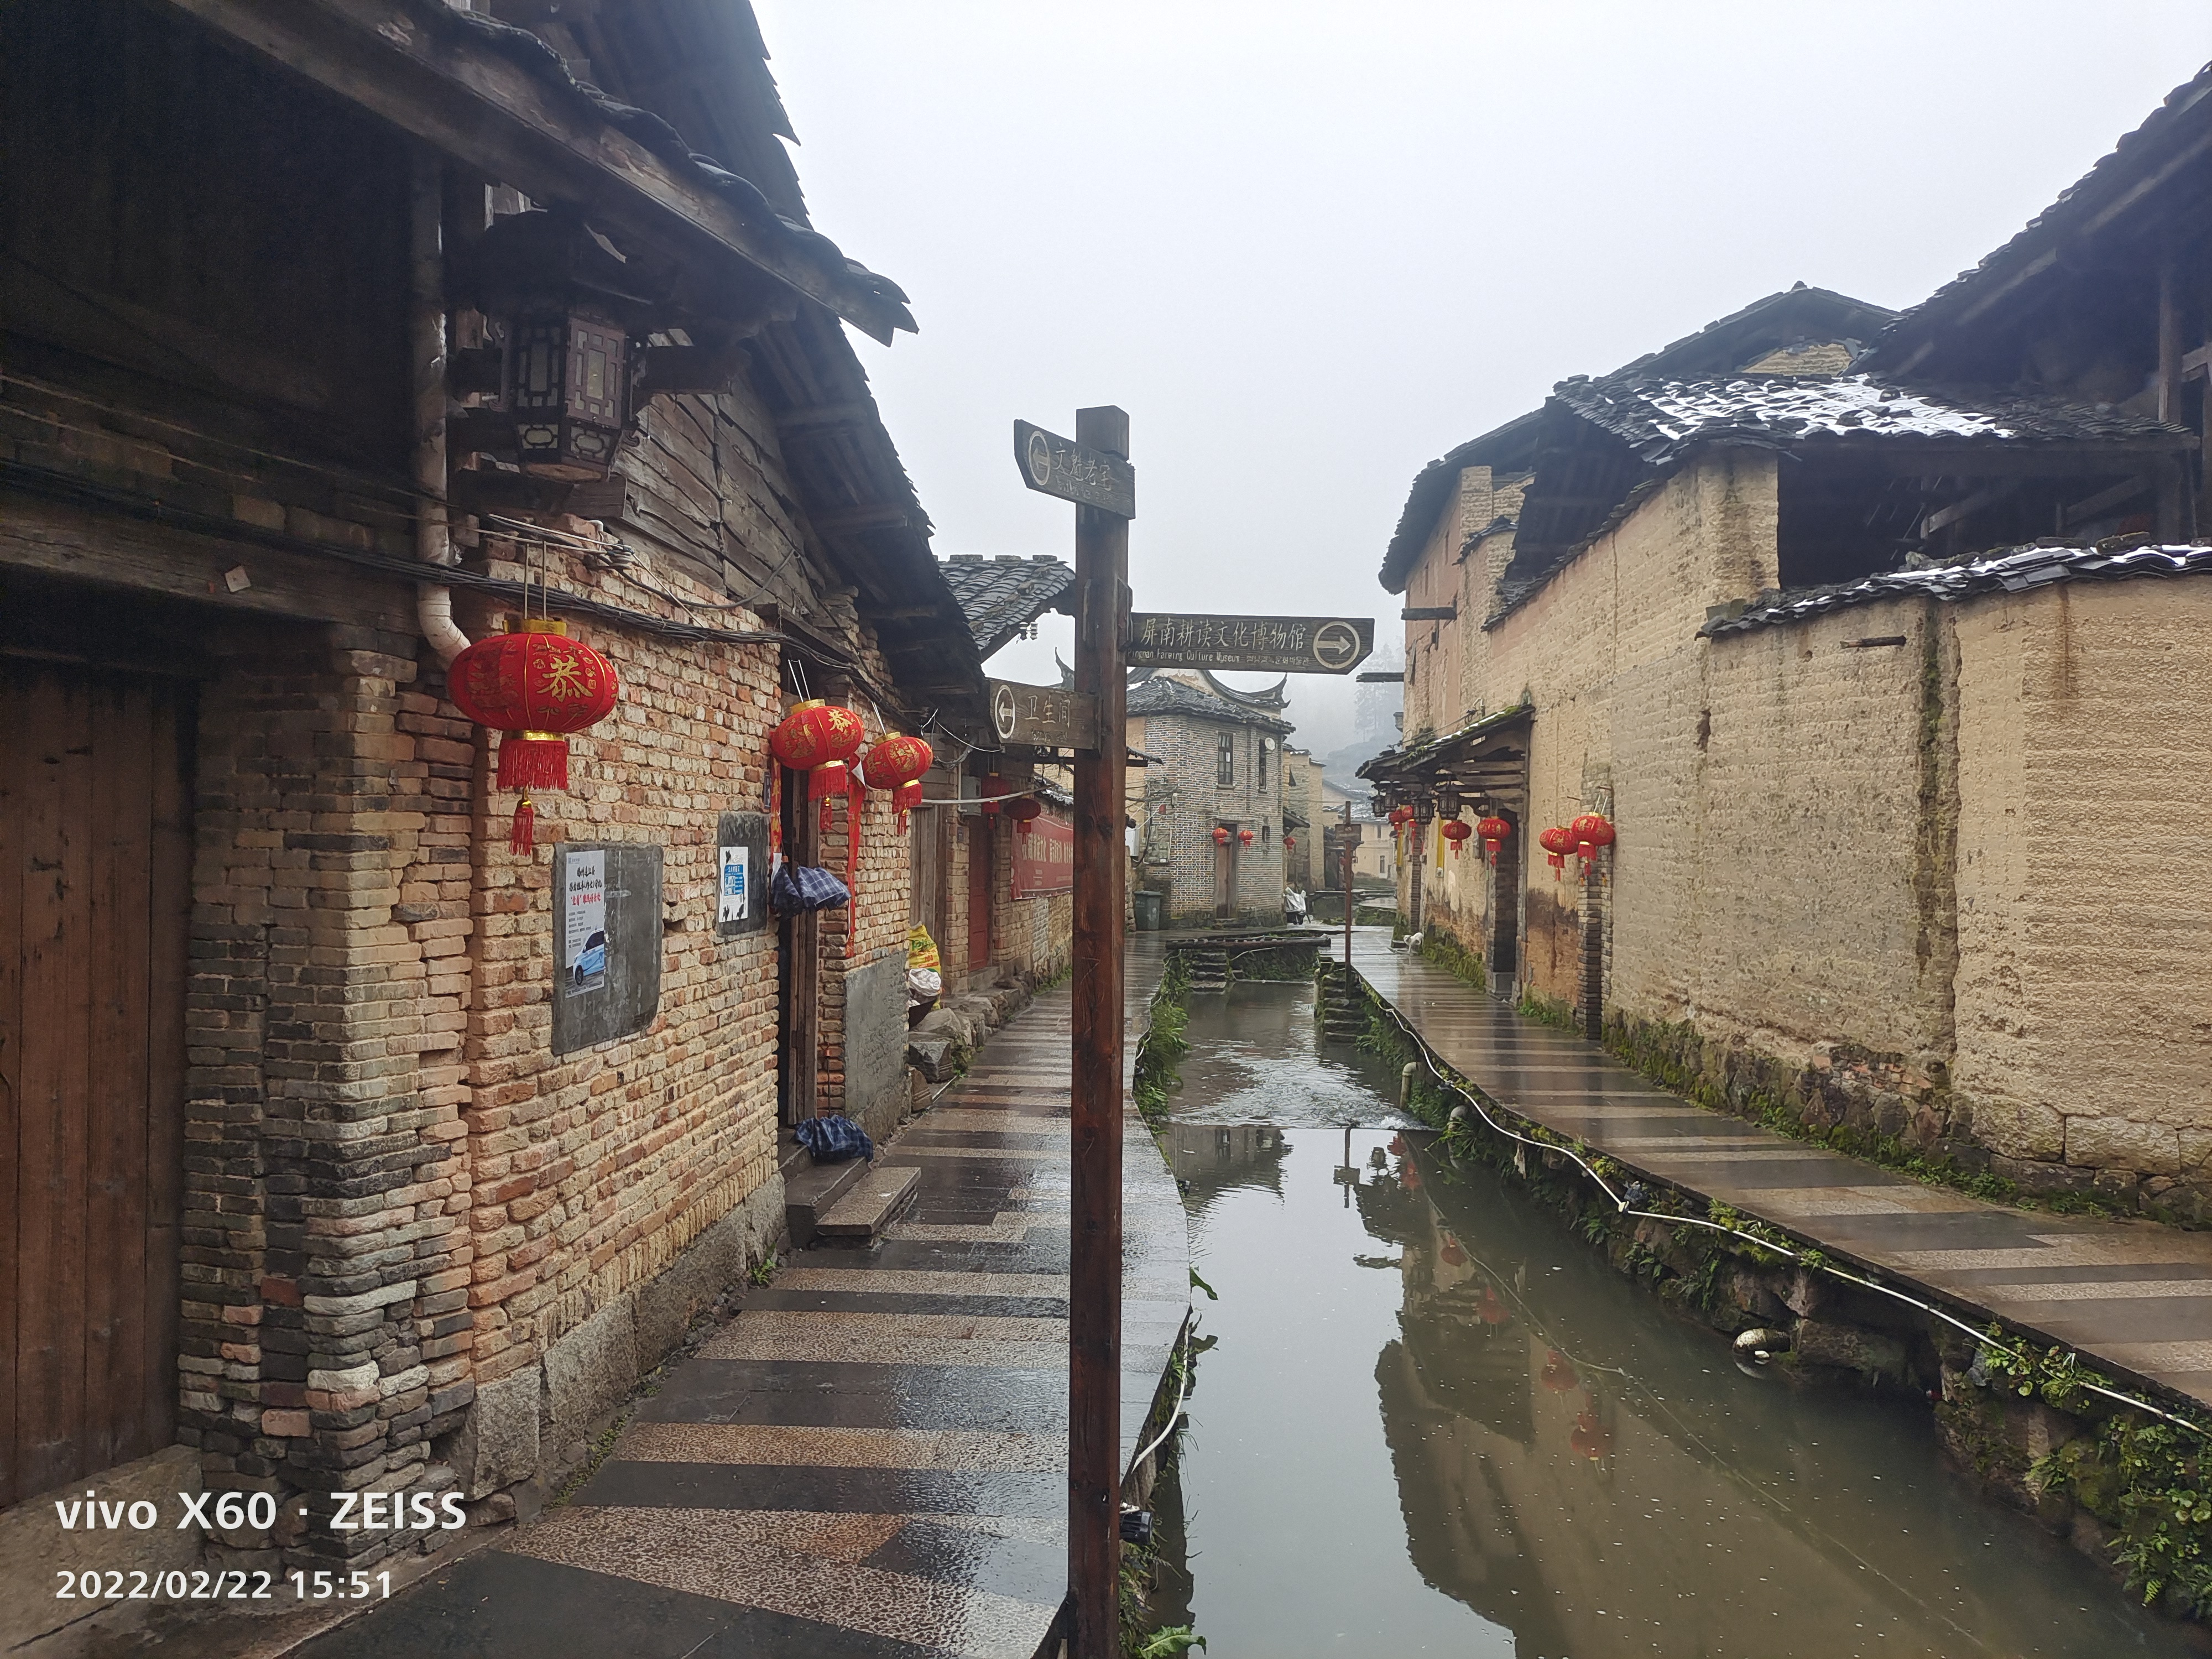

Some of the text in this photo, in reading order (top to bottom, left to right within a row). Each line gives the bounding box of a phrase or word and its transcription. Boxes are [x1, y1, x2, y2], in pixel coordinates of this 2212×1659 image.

[1052, 441, 1112, 491] 文魁老宅
[1140, 617, 1306, 652] 屏南耕读文化博物馆
[1187, 650, 1213, 662] Culture
[1217, 651, 1240, 664] Museum
[536, 654, 594, 703] 恭
[827, 709, 852, 732] 恭
[1024, 694, 1071, 729] 卫生间
